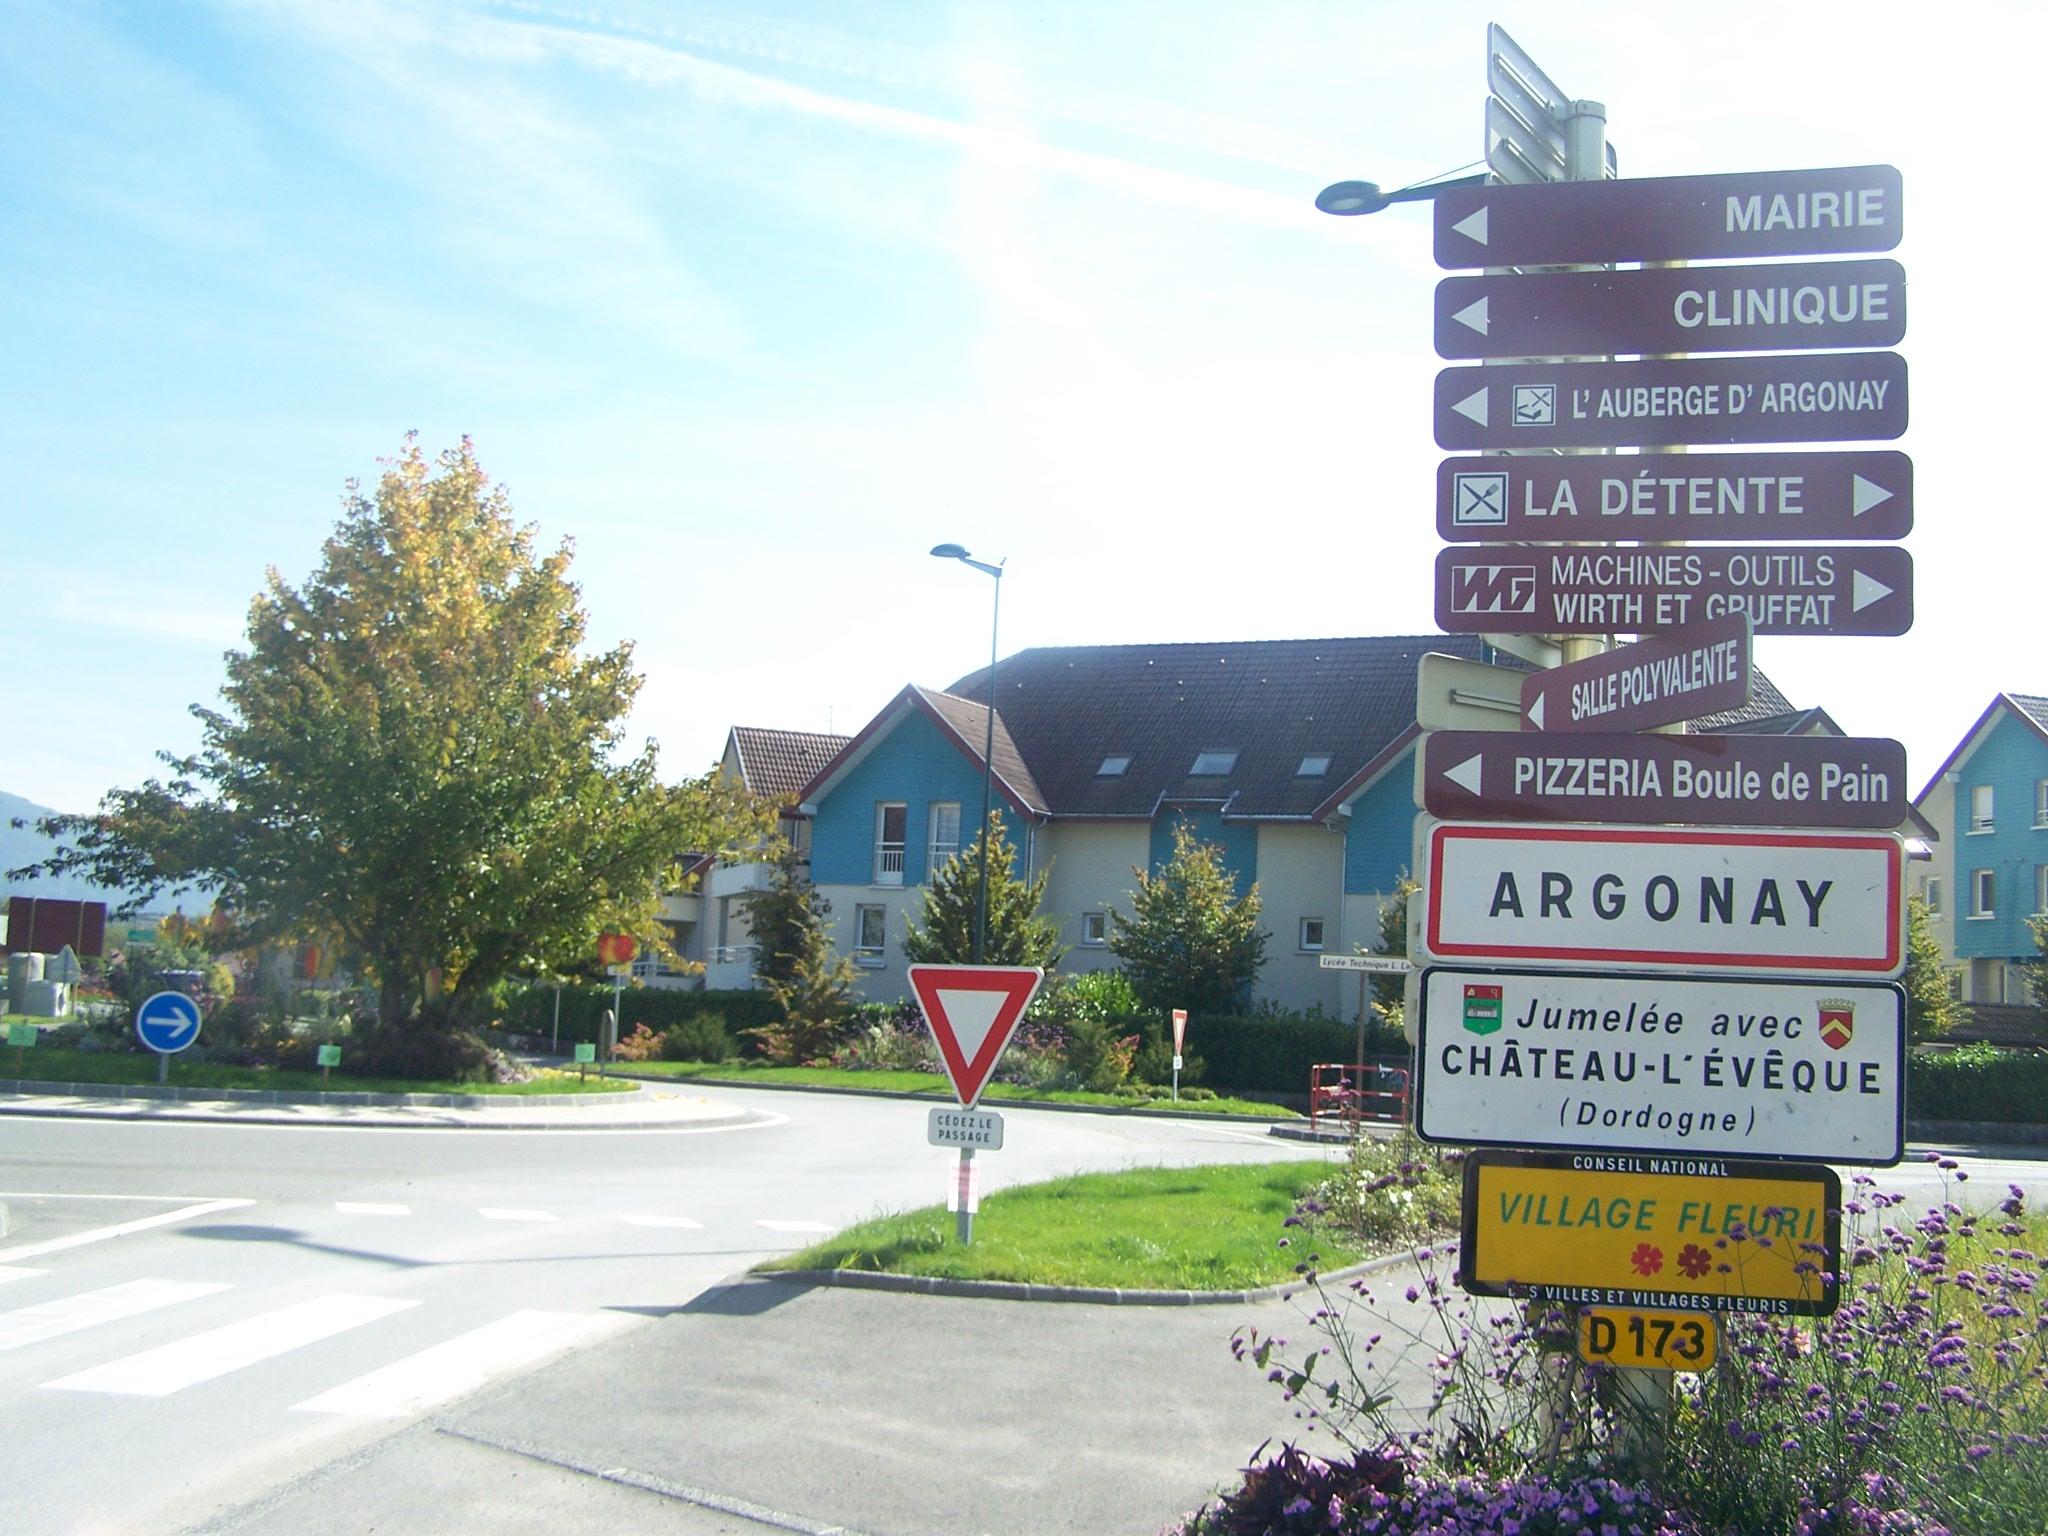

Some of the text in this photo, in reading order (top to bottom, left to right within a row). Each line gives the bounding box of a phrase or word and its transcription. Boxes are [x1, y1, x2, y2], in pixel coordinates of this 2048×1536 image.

[1726, 189, 1885, 232] MAIRIE
[1673, 284, 1889, 328] CLINIQUE
[1598, 386, 1721, 418] AUBERGE
[1763, 380, 1889, 413] ARGONAY
[1525, 470, 1804, 516] LA DÉTENTE
[1728, 554, 1835, 587] OUTILS
[1553, 594, 1643, 624] WIRTH
[1656, 594, 1688, 624] ET
[1571, 639, 1738, 721] SALLE POLYVALENTE
[1515, 757, 1888, 802] PIZZERIA Boule de Pain
[1489, 871, 1834, 928] ARGONAY
[1323, 957, 1346, 967] Lycée
[1350, 958, 1389, 970] Technique
[1516, 998, 1803, 1039] Jumelée avec
[938, 1115, 992, 1129] CÉDEZ LE
[938, 1130, 989, 1143] PASSAGE
[1559, 1097, 1756, 1137] (Dordogne)
[1573, 1155, 1729, 1177] CONSEIL NATIONAL
[1499, 1192, 1816, 1239] VILLAGE FLEURI
[1545, 1286, 1601, 1302] VILLES
[1606, 1290, 1625, 1303] ET
[1632, 1291, 1710, 1310] VILLAGES
[1717, 1296, 1789, 1314] FLEURIS
[1590, 1316, 1705, 1360] D 173
